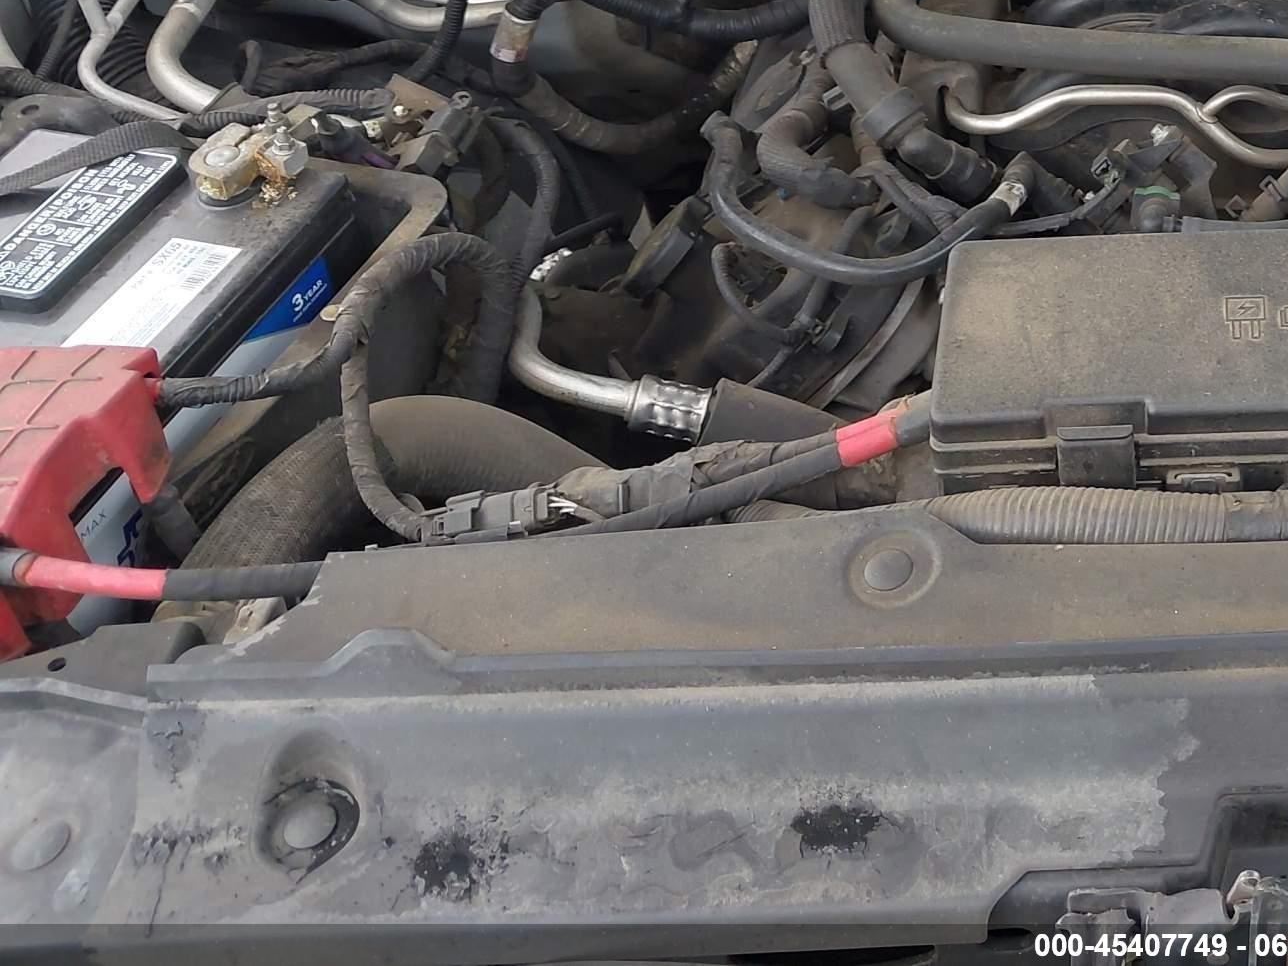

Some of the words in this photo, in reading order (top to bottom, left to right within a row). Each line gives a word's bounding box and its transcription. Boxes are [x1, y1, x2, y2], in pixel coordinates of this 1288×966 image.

[7, 169, 99, 250] DANGER/POISON
[292, 293, 304, 311] 3
[304, 279, 323, 301] YEAR
[80, 508, 107, 538] MAX
